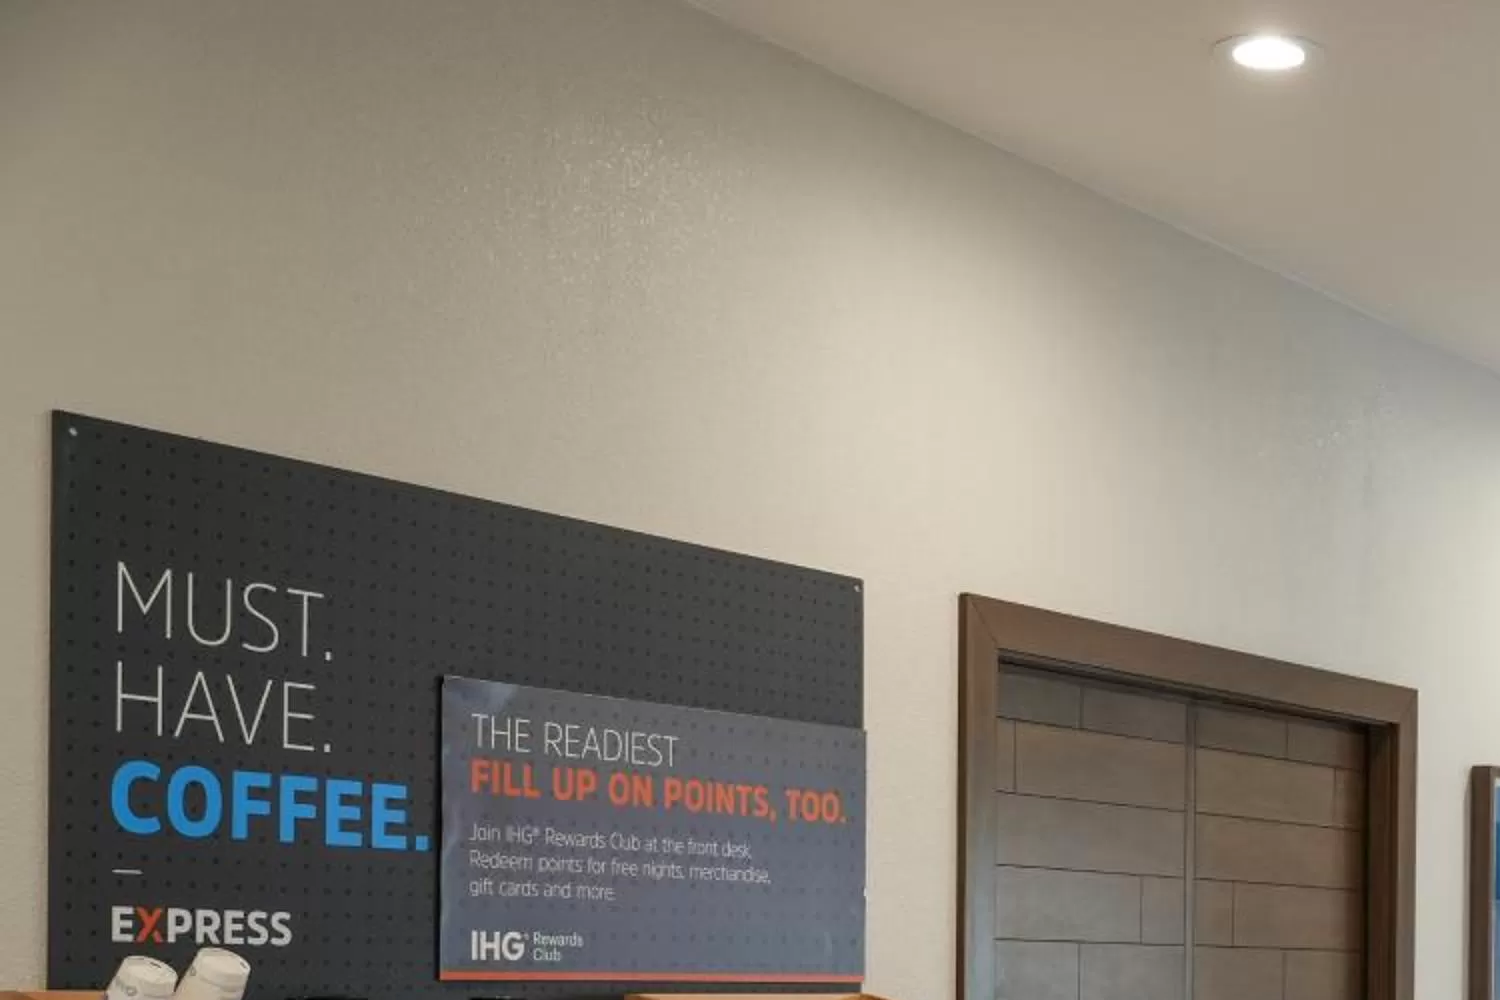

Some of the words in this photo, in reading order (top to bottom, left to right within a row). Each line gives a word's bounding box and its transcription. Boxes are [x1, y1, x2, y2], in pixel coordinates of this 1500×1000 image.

[117, 561, 332, 661] MUST.
[116, 660, 332, 752] HAVE.
[471, 713, 532, 753] THE
[543, 721, 679, 767] READIEST
[111, 759, 430, 851] COFFEE.
[470, 757, 542, 799] FILL
[553, 766, 597, 801] UP
[608, 772, 655, 808] ON
[663, 777, 777, 823] POINTS,
[785, 788, 847, 824] TOO.
[468, 823, 500, 842] Join
[545, 826, 606, 849] Rewards
[609, 831, 641, 851] Club
[644, 836, 658, 853] at
[662, 836, 684, 854] the
[687, 837, 718, 857] front
[468, 848, 533, 871] Redeem
[538, 856, 583, 874] points
[587, 855, 607, 875] for
[611, 857, 639, 877] free
[468, 877, 494, 898] gift
[499, 880, 540, 898] cards
[543, 881, 572, 900] and
[111, 905, 293, 947] EXPRESS
[533, 930, 585, 949] Rewards
[533, 946, 563, 961] Club
